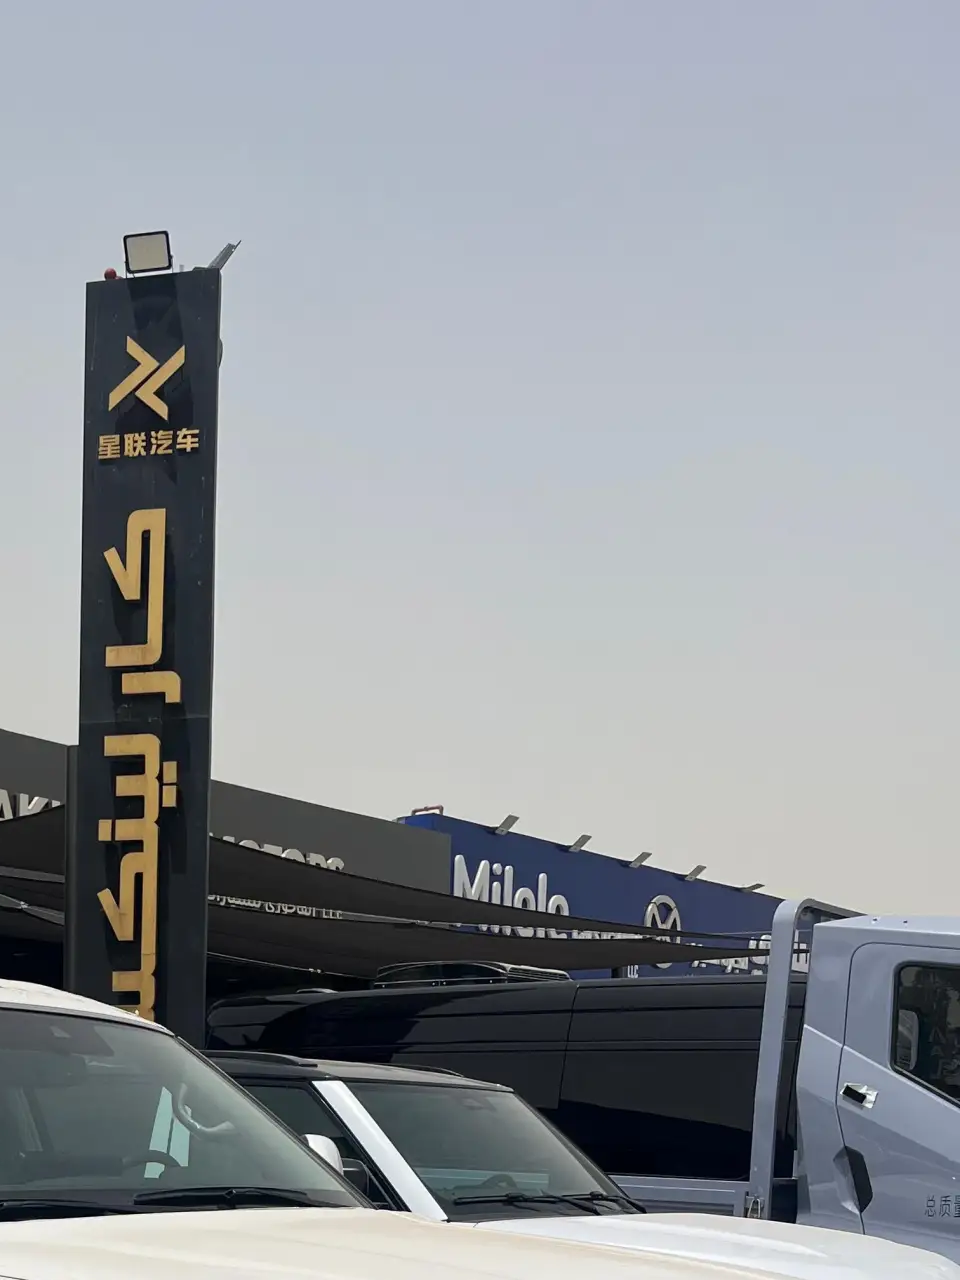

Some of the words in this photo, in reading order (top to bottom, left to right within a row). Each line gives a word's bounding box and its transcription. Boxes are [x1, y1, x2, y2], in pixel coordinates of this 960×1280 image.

[98, 428, 200, 459] 星联汽车
[103, 508, 182, 704] كار
